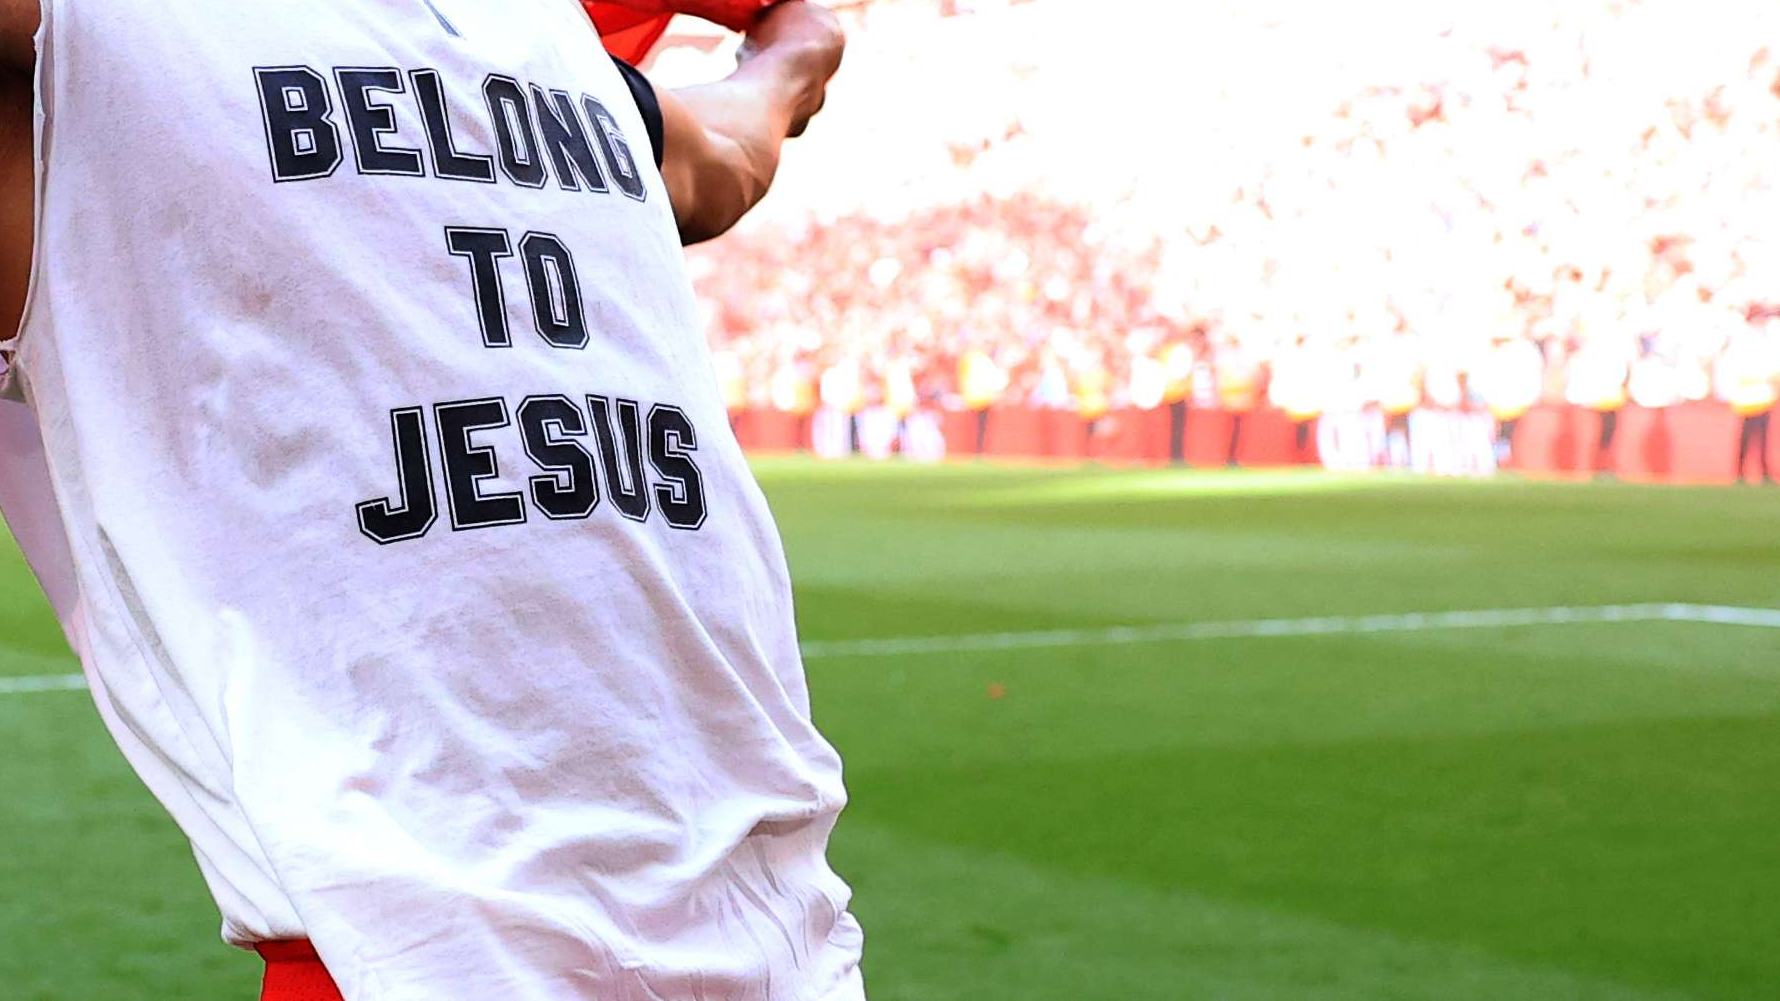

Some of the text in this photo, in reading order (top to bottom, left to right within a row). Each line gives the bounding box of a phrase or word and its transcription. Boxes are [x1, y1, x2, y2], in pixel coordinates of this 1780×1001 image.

[252, 65, 647, 203] BELONG
[443, 226, 590, 350] TO
[355, 393, 708, 545] JESUS
